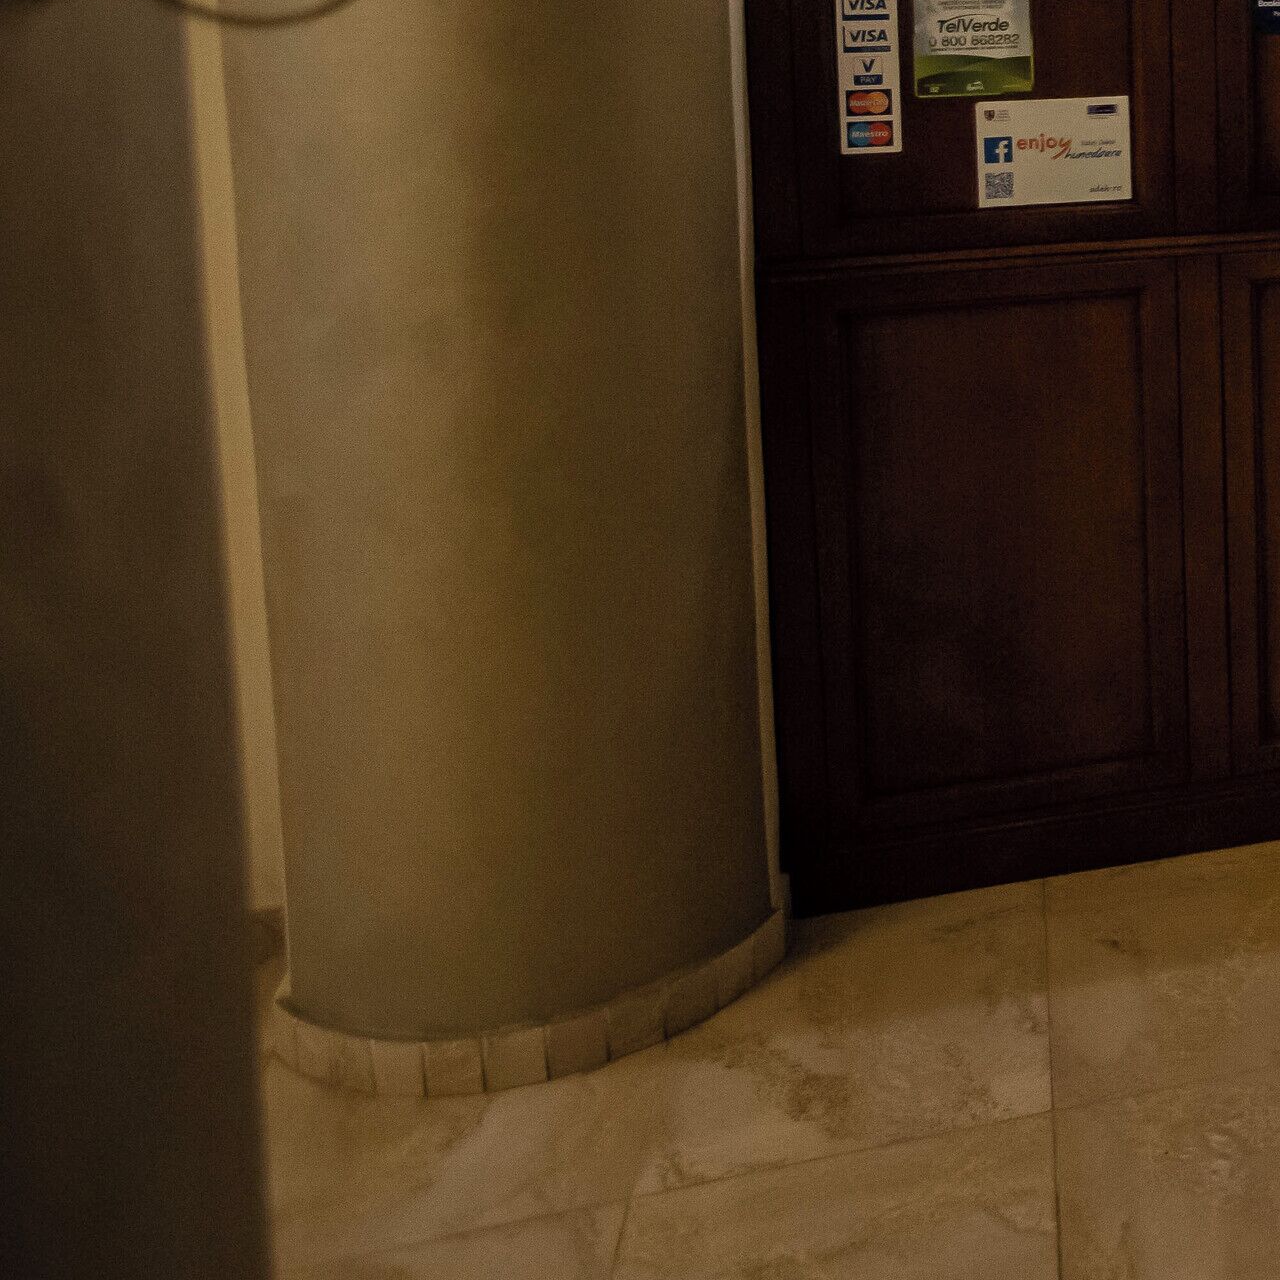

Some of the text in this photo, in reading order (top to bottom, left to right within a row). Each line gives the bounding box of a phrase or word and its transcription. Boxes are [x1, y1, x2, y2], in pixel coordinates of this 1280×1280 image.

[937, 17, 1009, 34] TelVerde
[849, 28, 888, 43] VISA
[861, 58, 876, 73] V
[1016, 132, 1072, 160] enjoy
